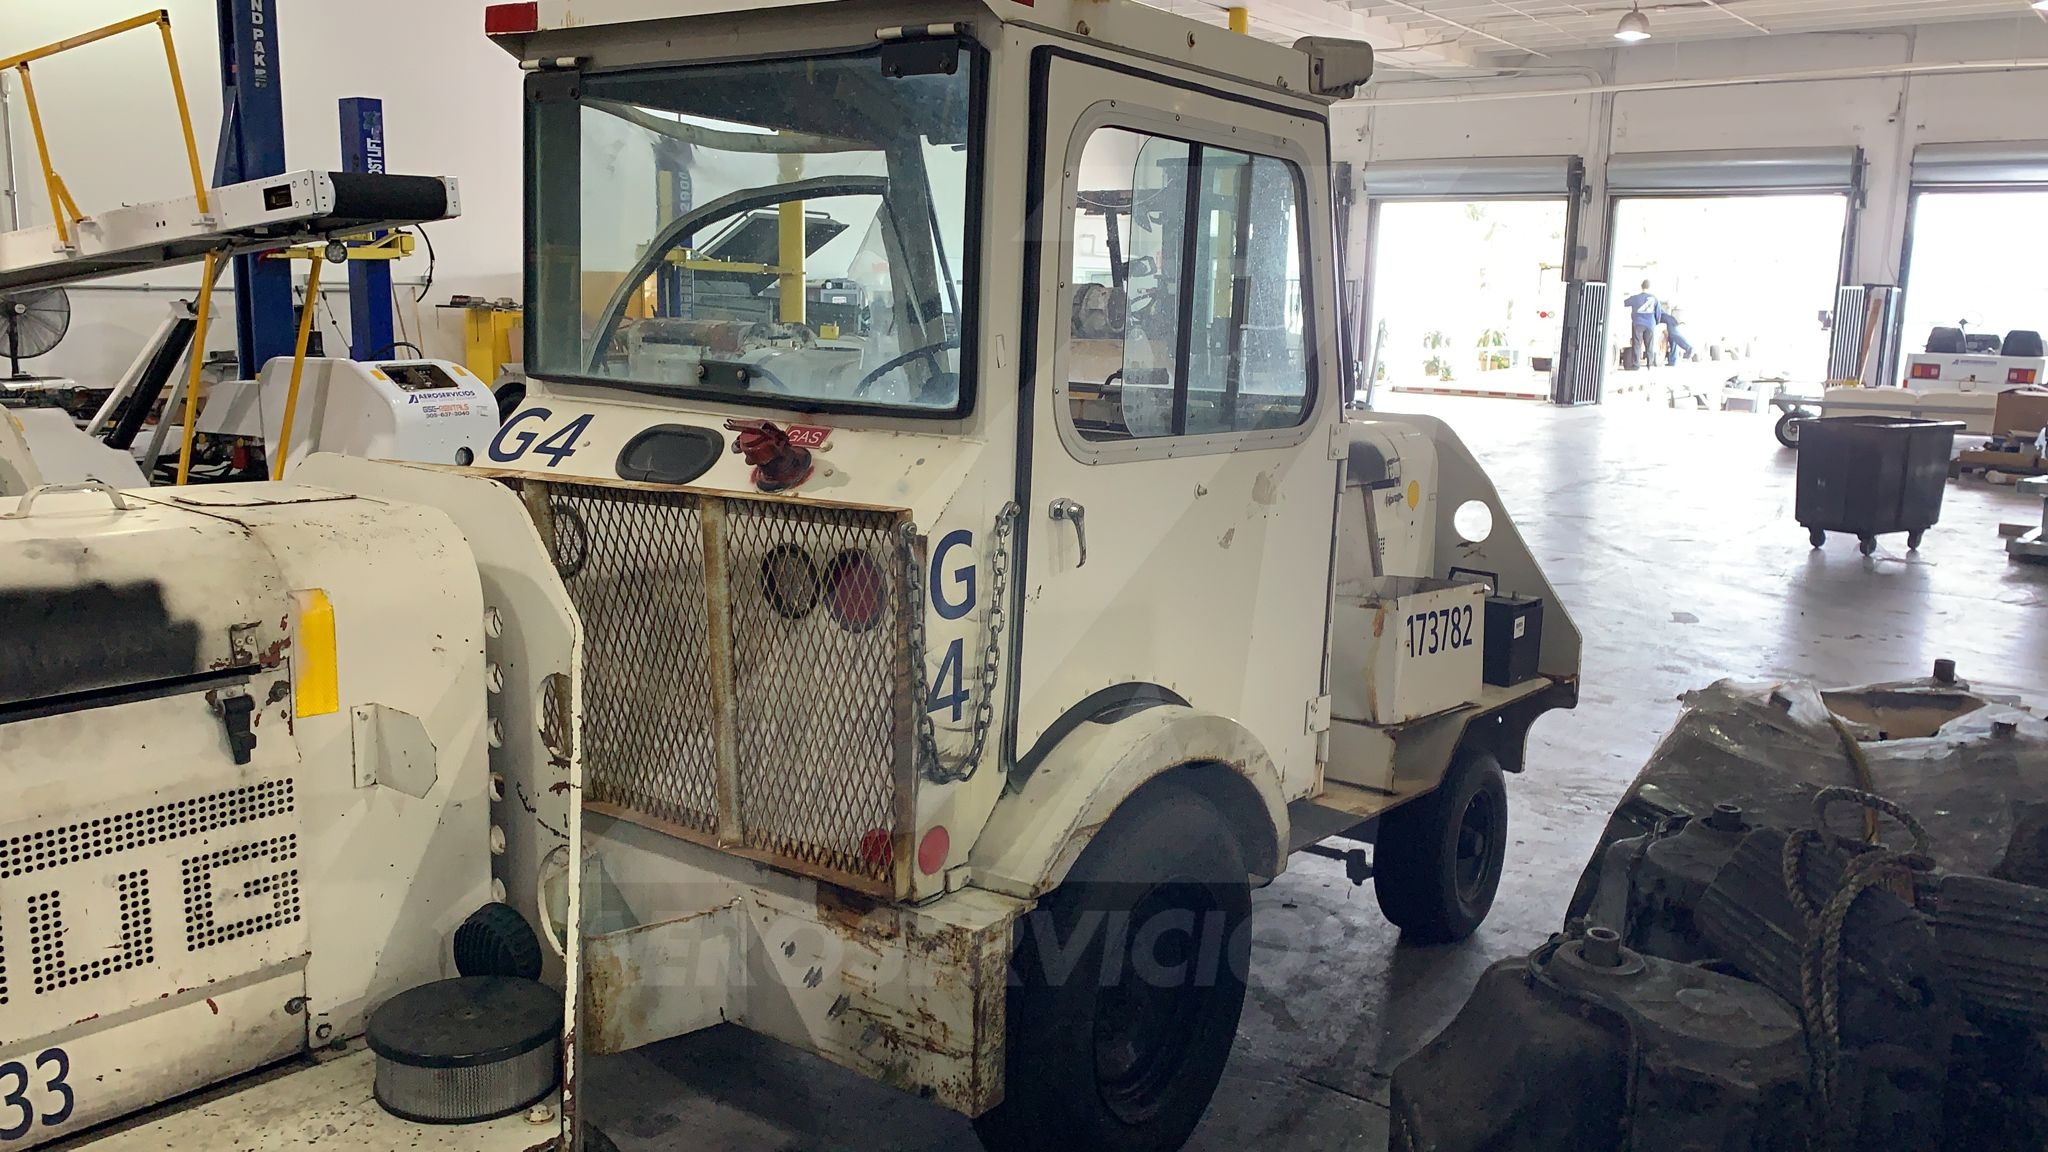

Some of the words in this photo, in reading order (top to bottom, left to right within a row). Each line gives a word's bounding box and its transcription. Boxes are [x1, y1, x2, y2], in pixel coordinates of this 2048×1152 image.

[418, 390, 475, 399] AEROSERVICIOS
[487, 407, 595, 467] G4
[787, 429, 823, 444] GAS
[1406, 604, 1473, 658] 173782
